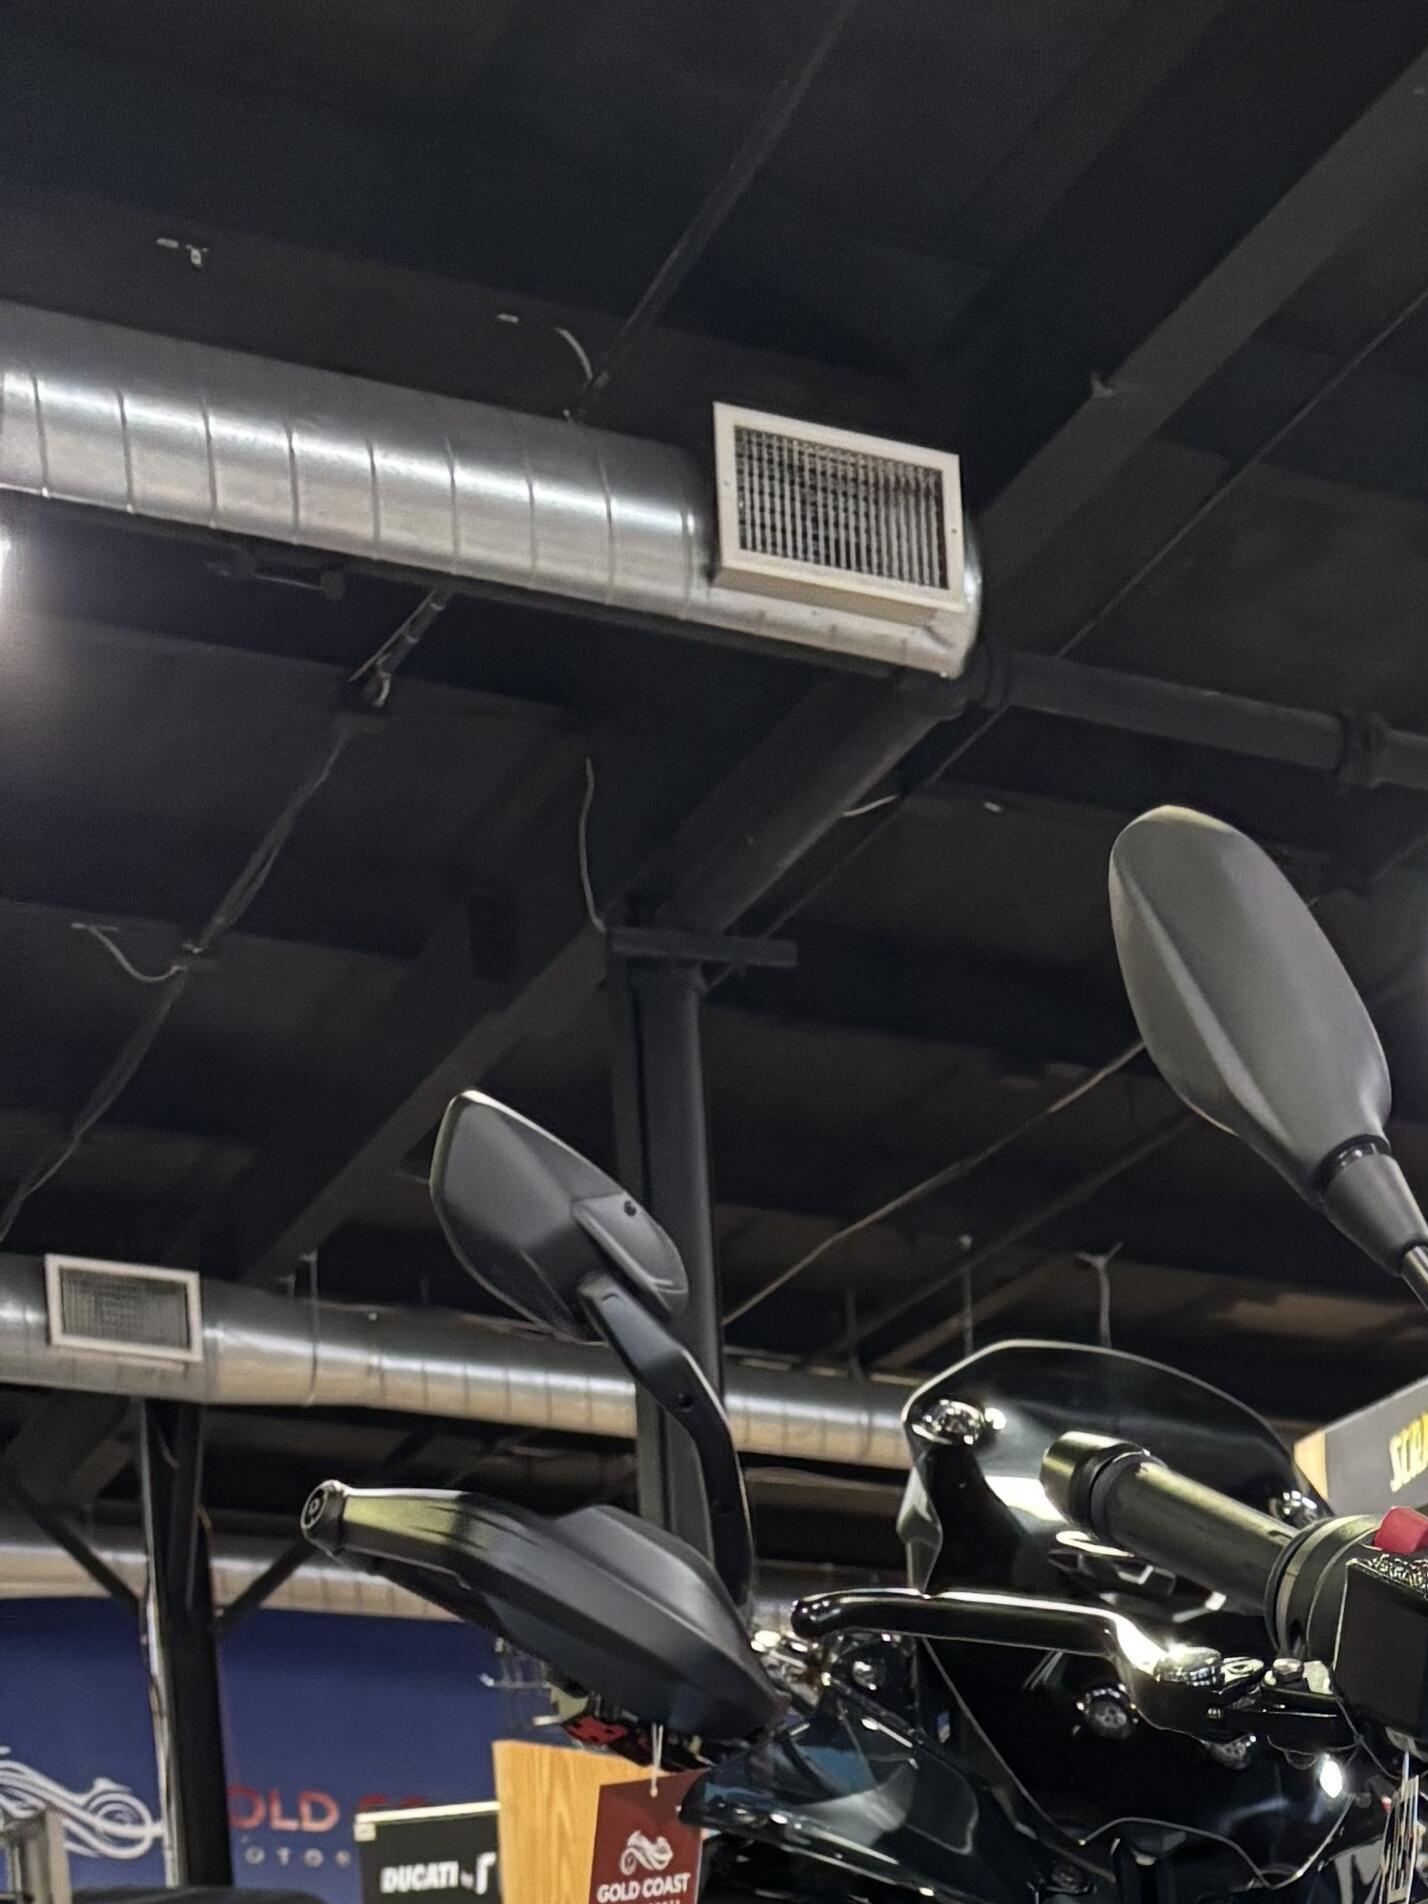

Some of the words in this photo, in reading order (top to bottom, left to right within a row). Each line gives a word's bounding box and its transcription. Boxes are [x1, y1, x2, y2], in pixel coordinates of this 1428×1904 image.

[226, 1784, 340, 1833] OLD
[380, 1860, 459, 1893] DUCATI
[597, 1882, 641, 1904] GOLD
[642, 1873, 692, 1899] COAST
